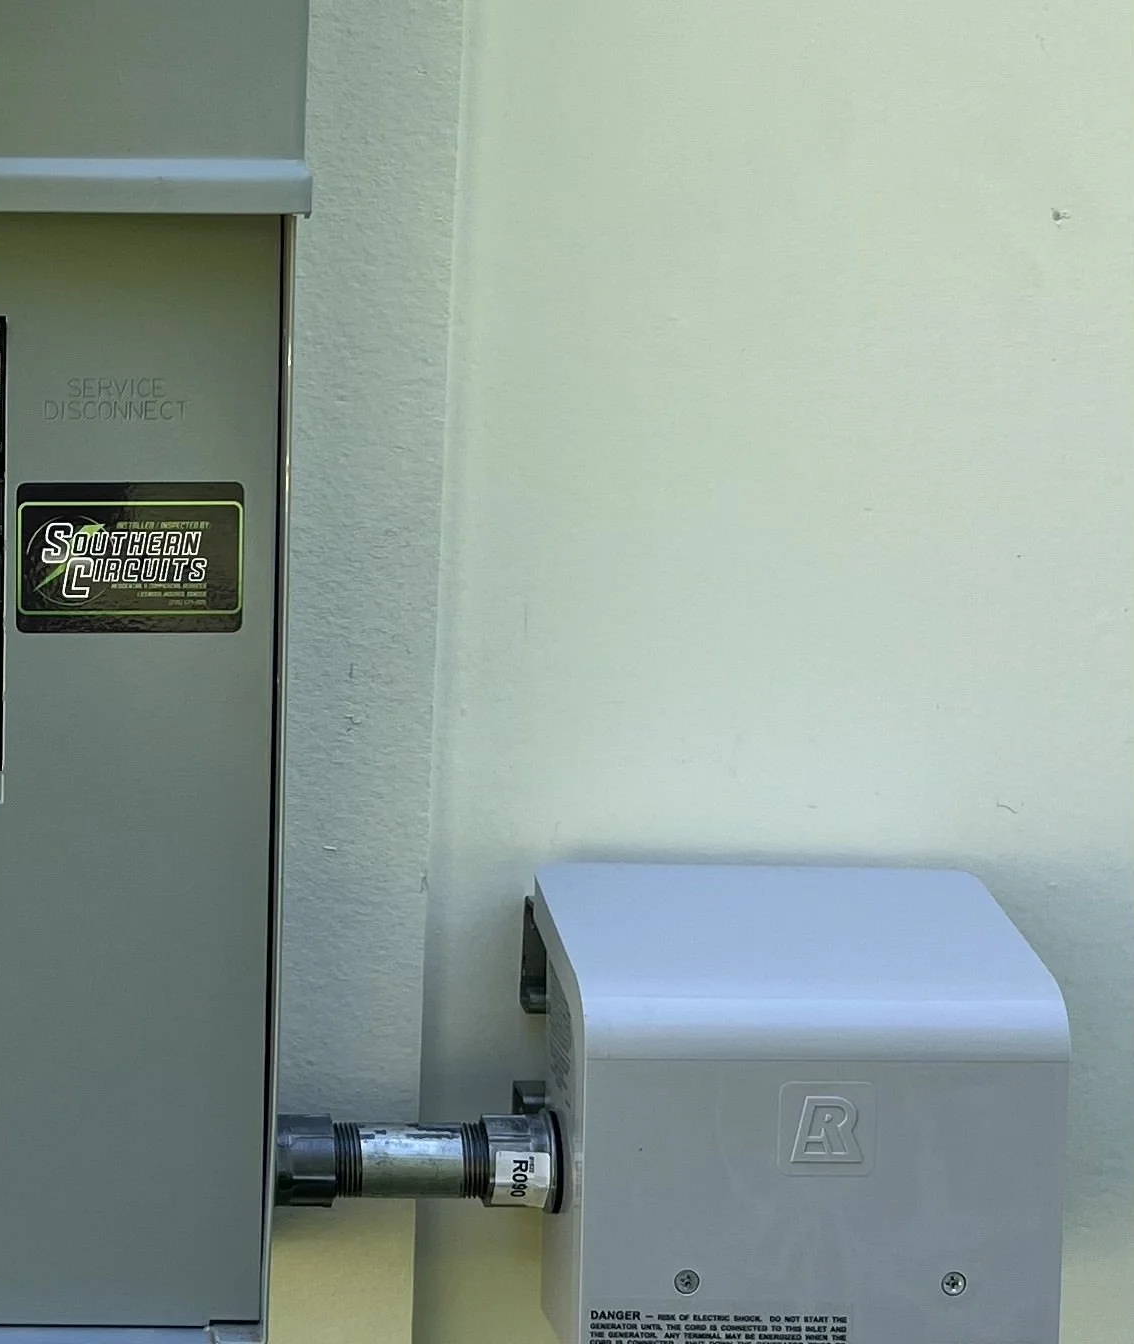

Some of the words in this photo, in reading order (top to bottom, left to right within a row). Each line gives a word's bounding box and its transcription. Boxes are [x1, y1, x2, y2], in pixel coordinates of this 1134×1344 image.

[68, 377, 166, 398] SERVICE
[44, 400, 192, 420] DISCONNECT
[42, 522, 202, 564] SOUTHERN
[62, 557, 208, 598] CIRCUITS
[510, 1160, 528, 1197] R090
[590, 1310, 641, 1320] DANGER
